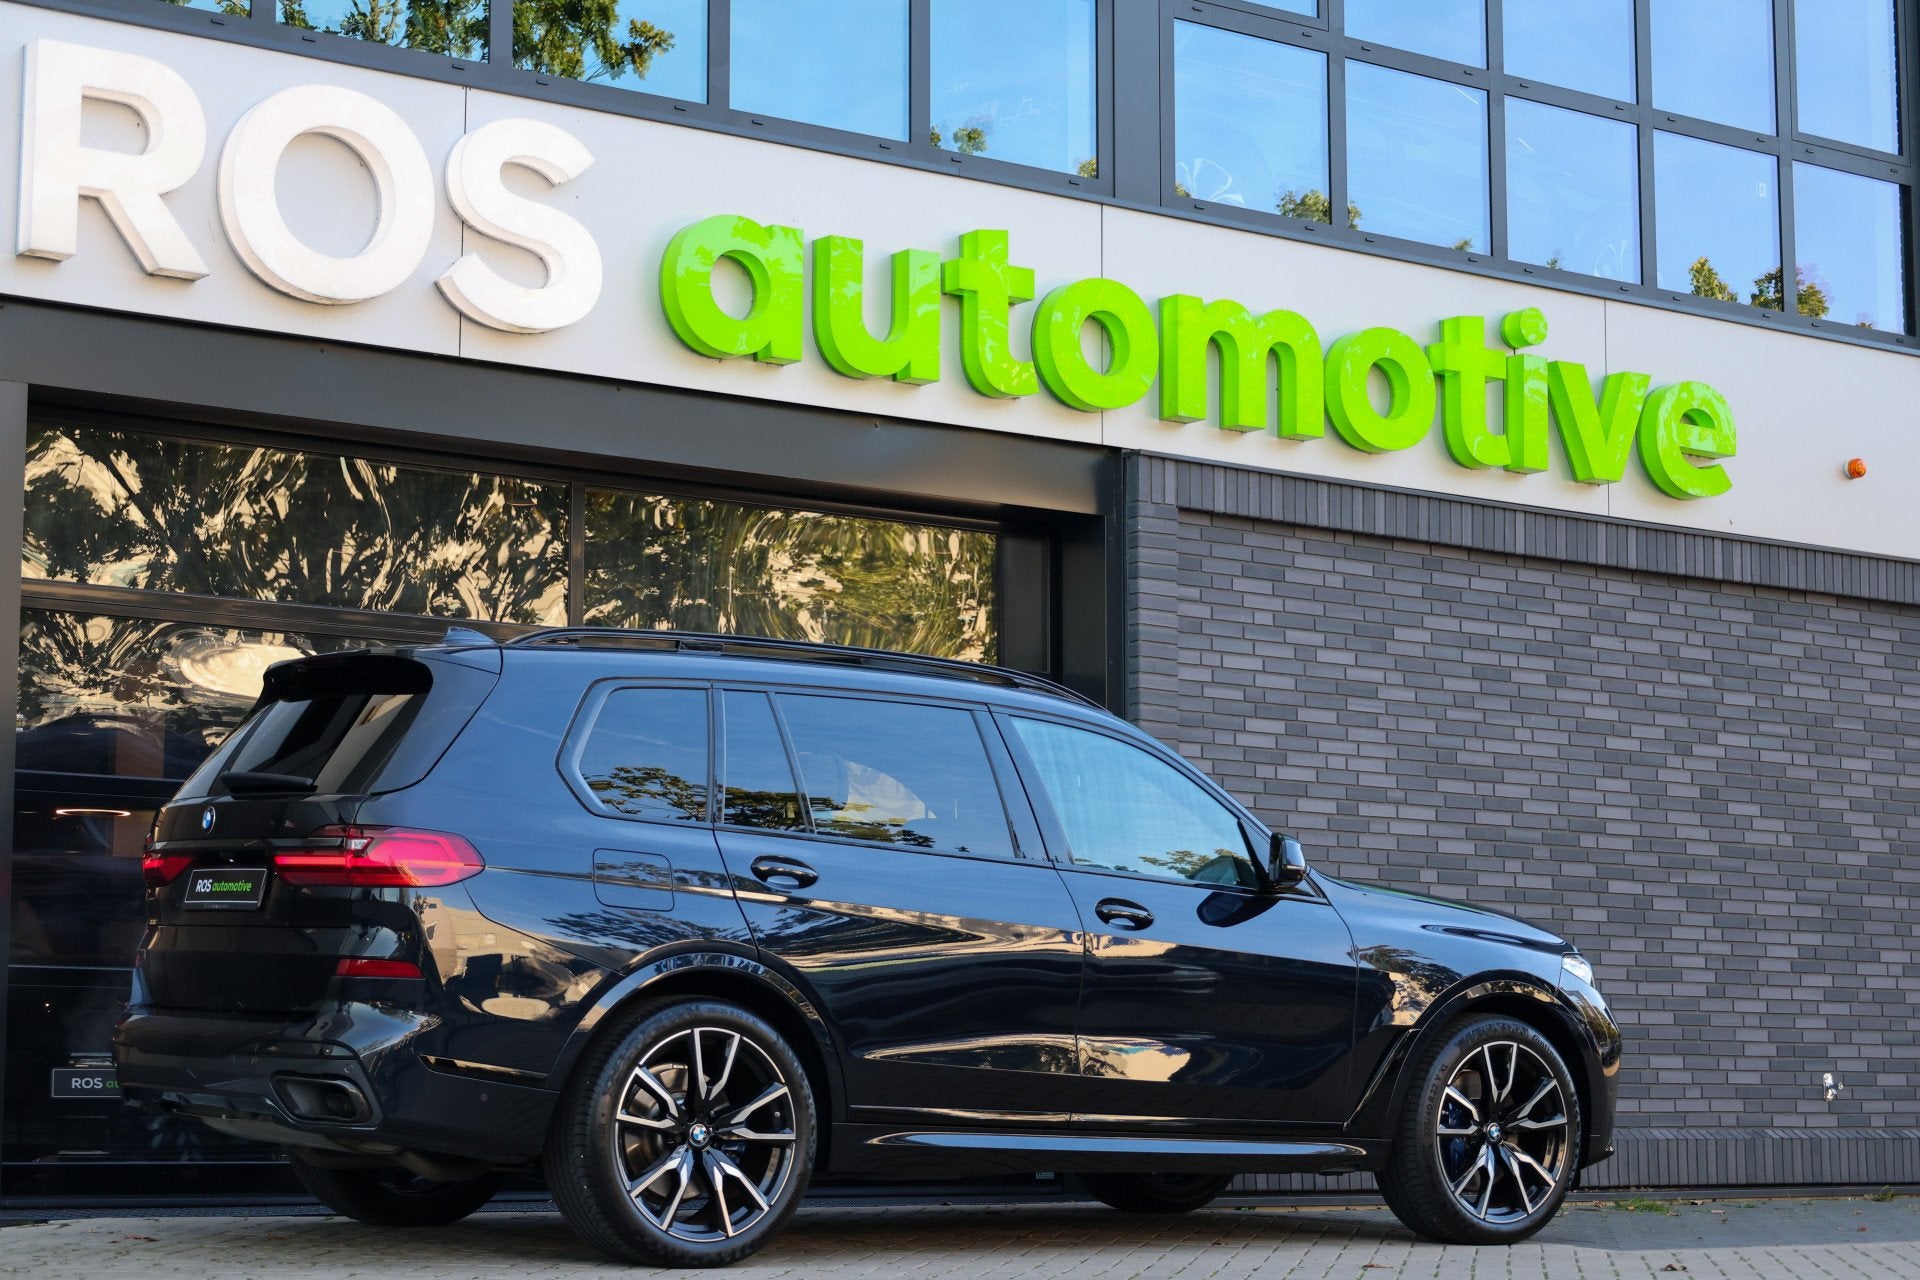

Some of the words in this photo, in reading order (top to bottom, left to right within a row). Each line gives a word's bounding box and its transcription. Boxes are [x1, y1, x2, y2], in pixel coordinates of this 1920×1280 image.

[15, 37, 604, 334] ROS
[658, 213, 1737, 499] automotive
[195, 879, 212, 893] ROS
[212, 879, 252, 892] automotive
[71, 1077, 103, 1089] ROS
[1429, 1083, 1439, 1096] 22
[1439, 1063, 1449, 1074] XL
